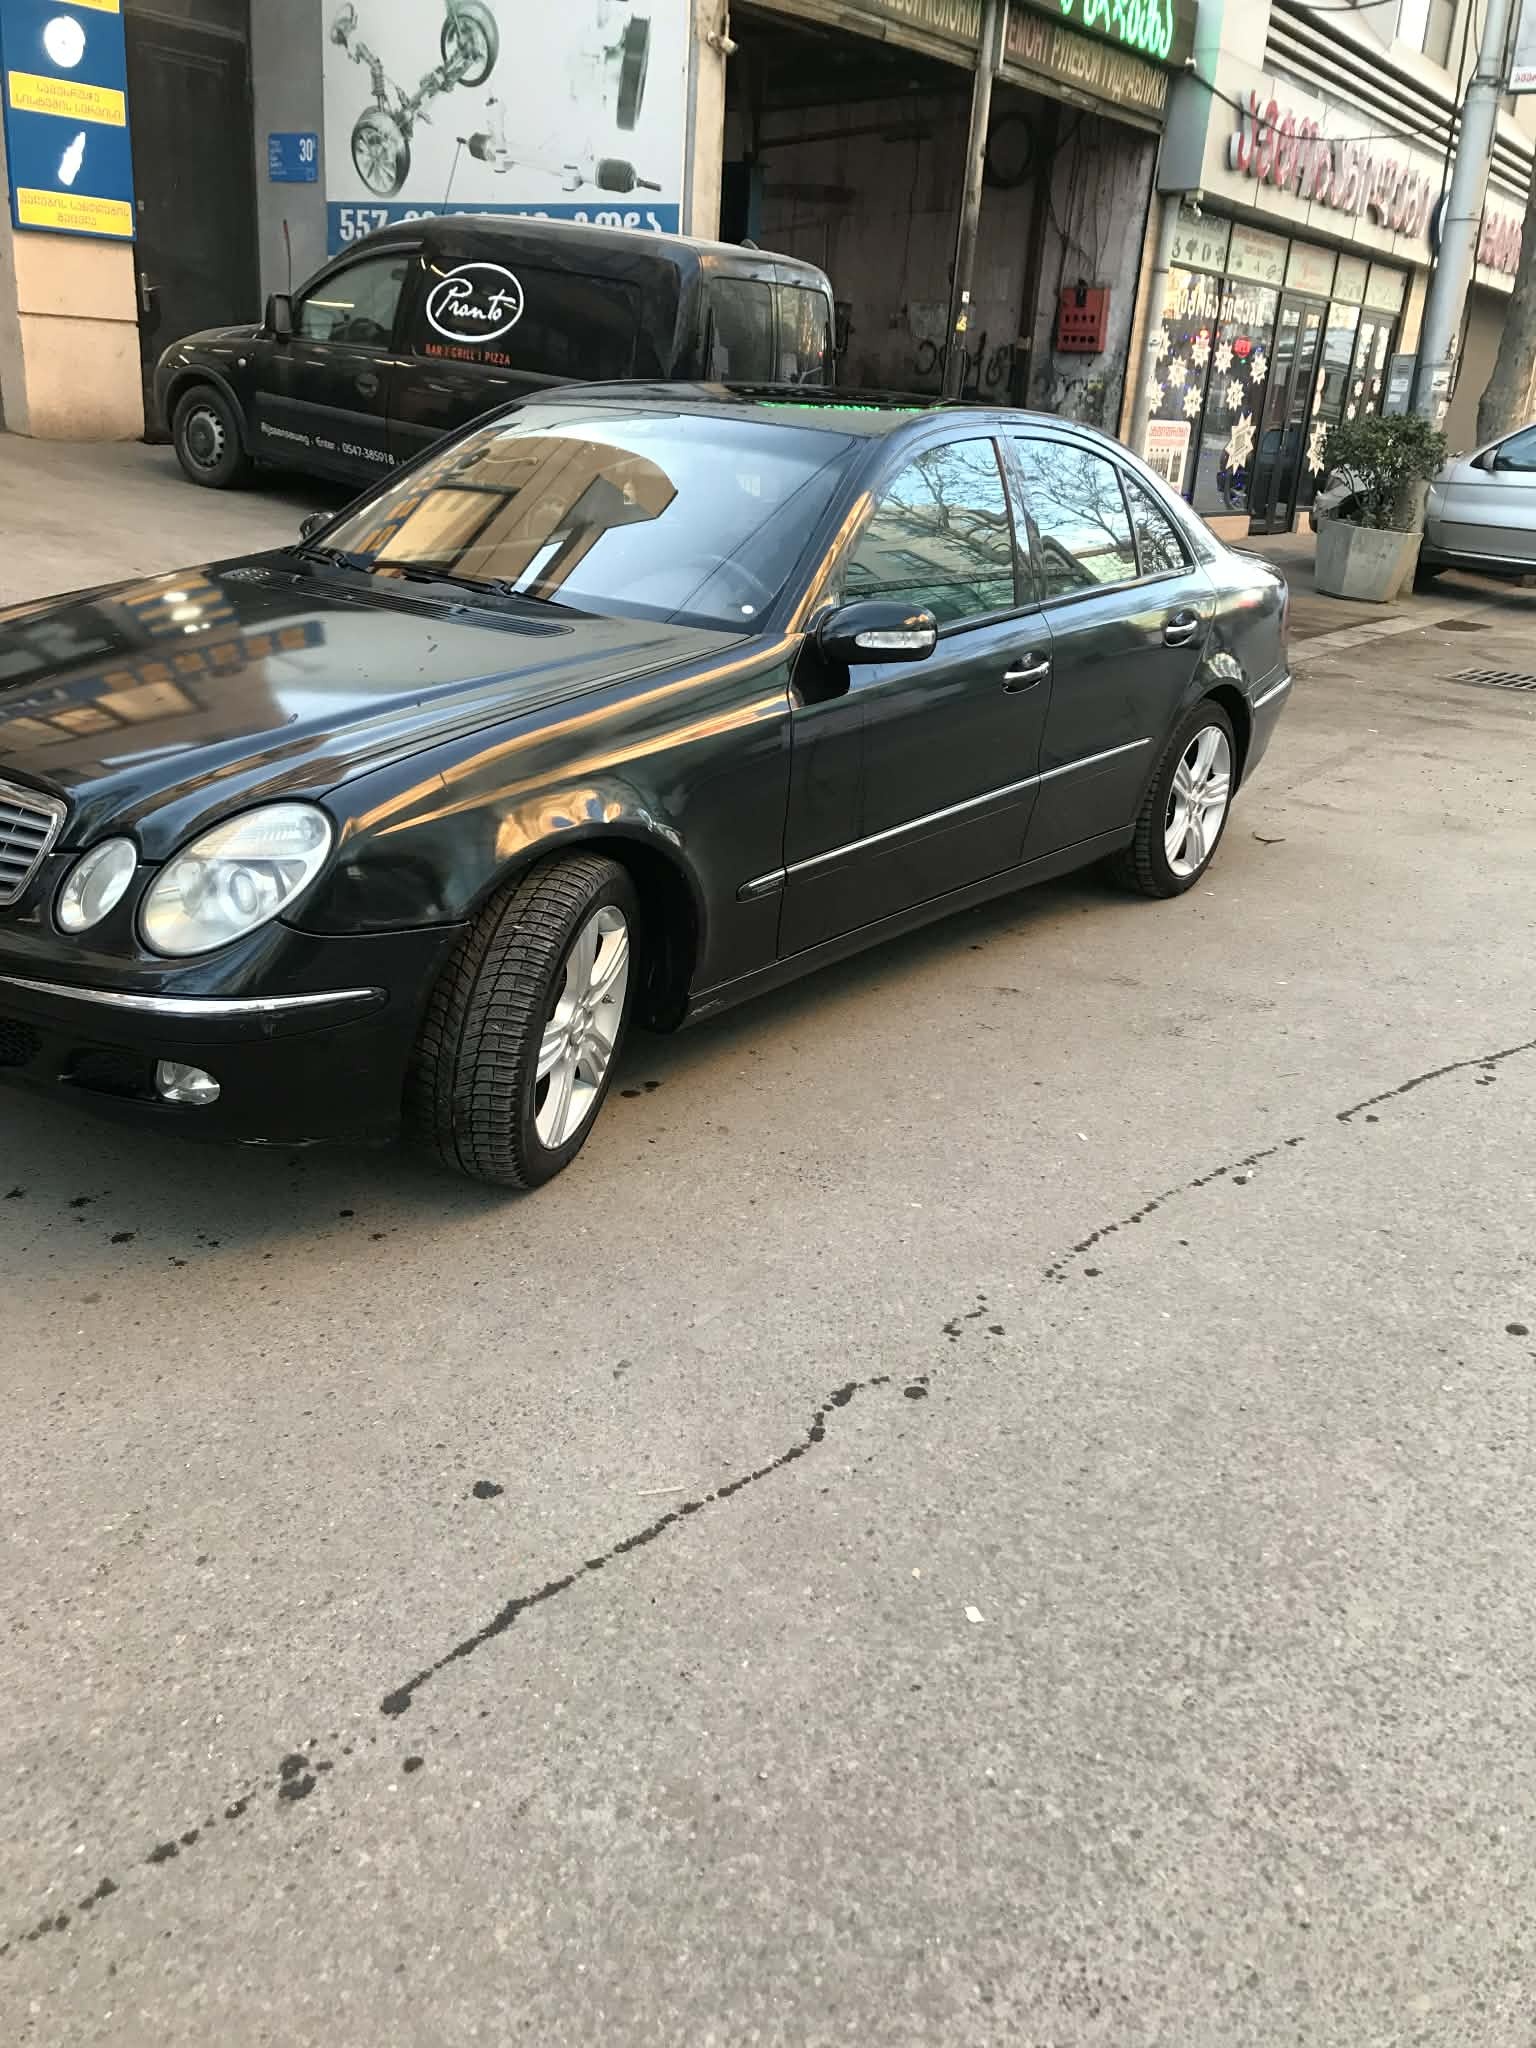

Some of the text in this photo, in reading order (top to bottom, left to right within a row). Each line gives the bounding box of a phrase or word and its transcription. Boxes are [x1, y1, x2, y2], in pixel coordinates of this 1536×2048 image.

[1007, 14, 1049, 64] ЕМОНТ
[299, 138, 313, 162] 30
[485, 351, 511, 365] PIZZA
